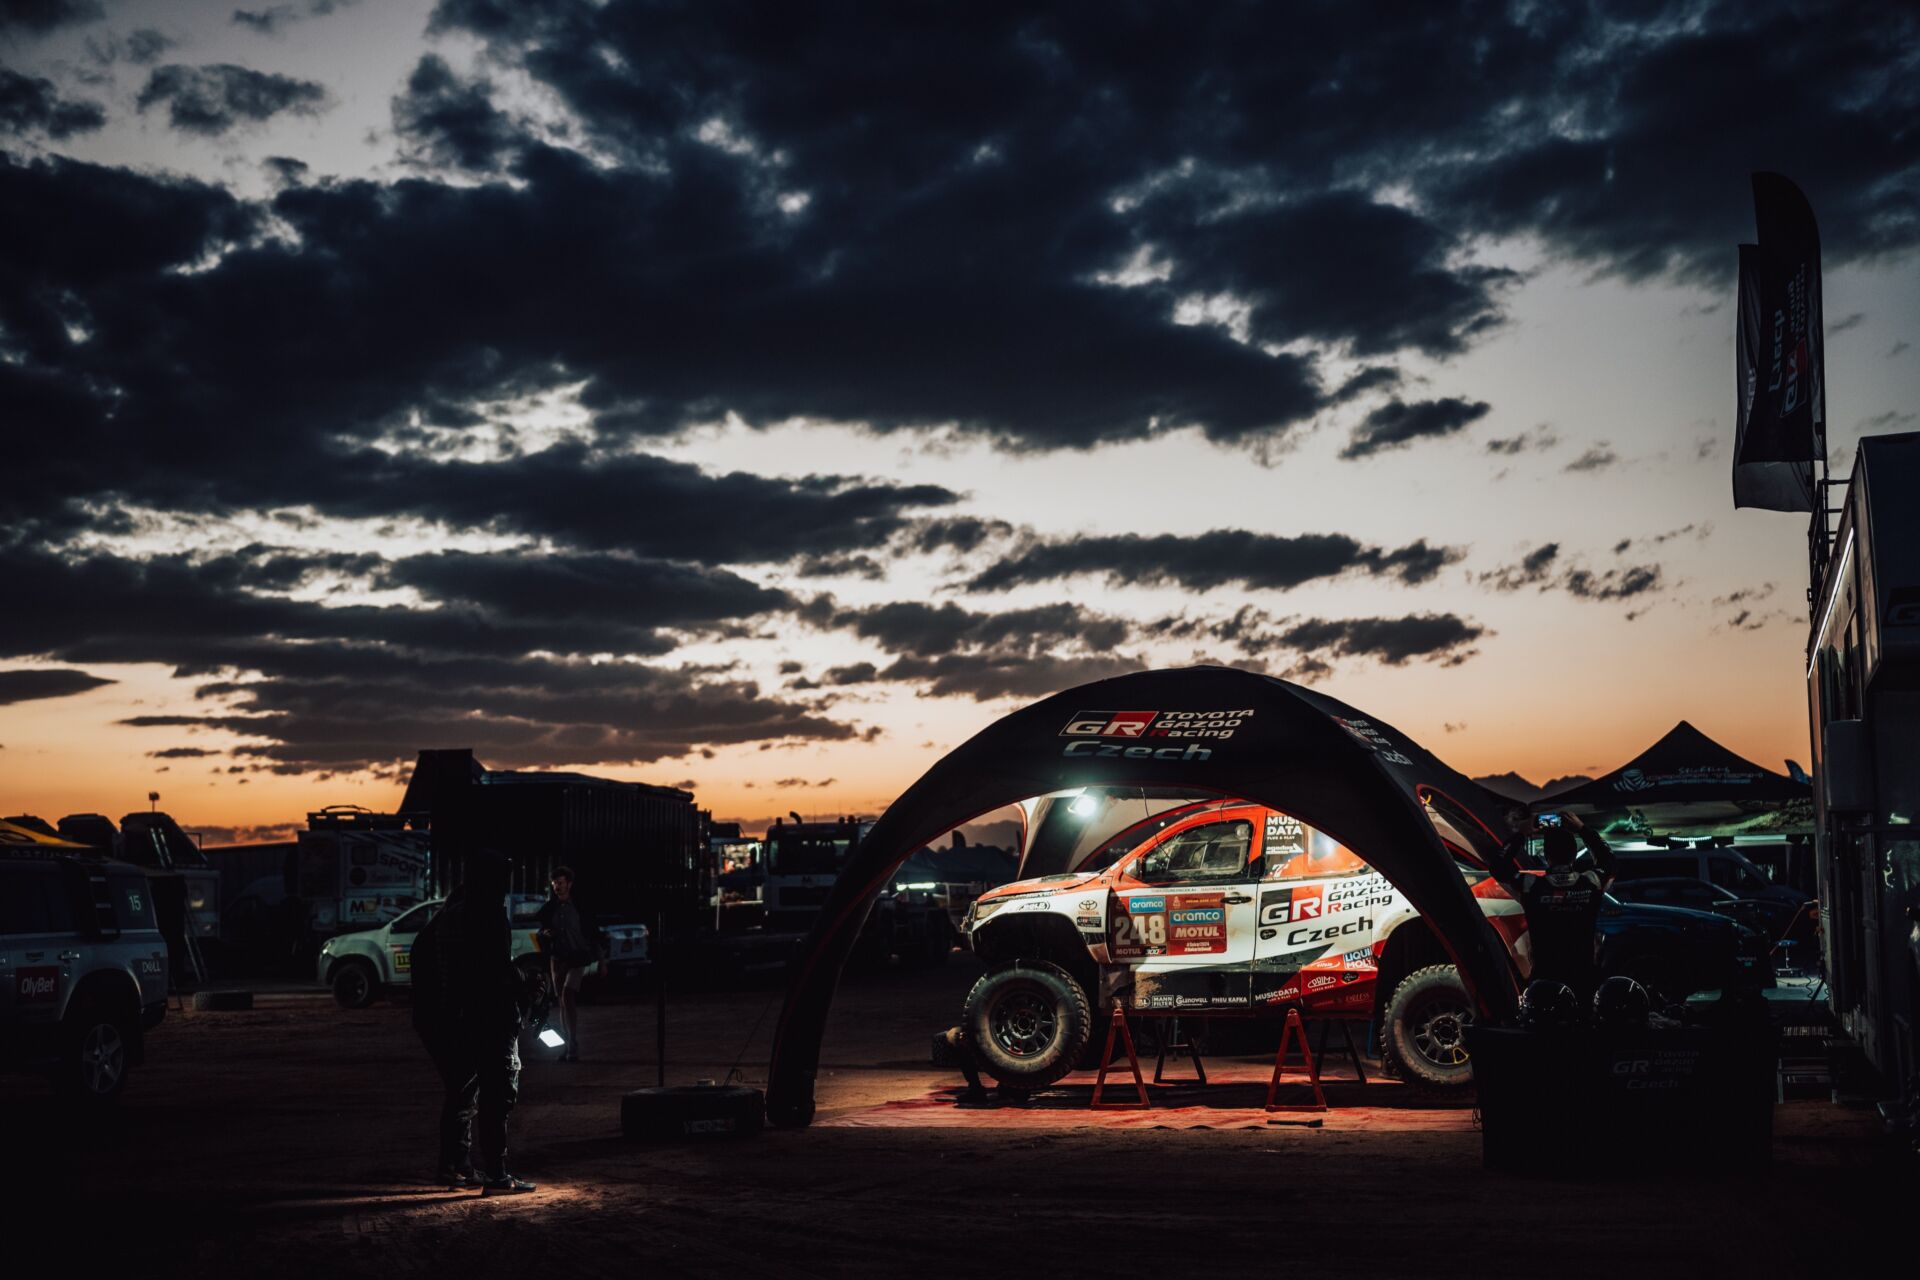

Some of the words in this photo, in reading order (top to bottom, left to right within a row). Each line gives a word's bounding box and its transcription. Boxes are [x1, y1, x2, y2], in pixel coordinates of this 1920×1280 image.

[1164, 708, 1255, 720] TOYOTA
[1064, 720, 1146, 737] GR
[1154, 718, 1243, 729] GAZOO
[1149, 728, 1235, 740] Racing
[1061, 739, 1213, 761] Czech
[1267, 825, 1303, 836] DATA
[1331, 876, 1388, 890] TOYOT
[129, 895, 142, 912] 15
[1131, 900, 1164, 909] aramco
[1260, 896, 1321, 925] GR
[1327, 894, 1393, 914] Racing
[1173, 911, 1220, 922] aramco
[1114, 914, 1166, 945] 248
[1175, 926, 1220, 938] MOTUL
[1287, 915, 1374, 946] Czech
[1344, 947, 1372, 962] LIQUI
[1346, 956, 1373, 969] MOLY
[20, 976, 55, 997] OlyBet
[1254, 987, 1299, 1001] MUSICDATA
